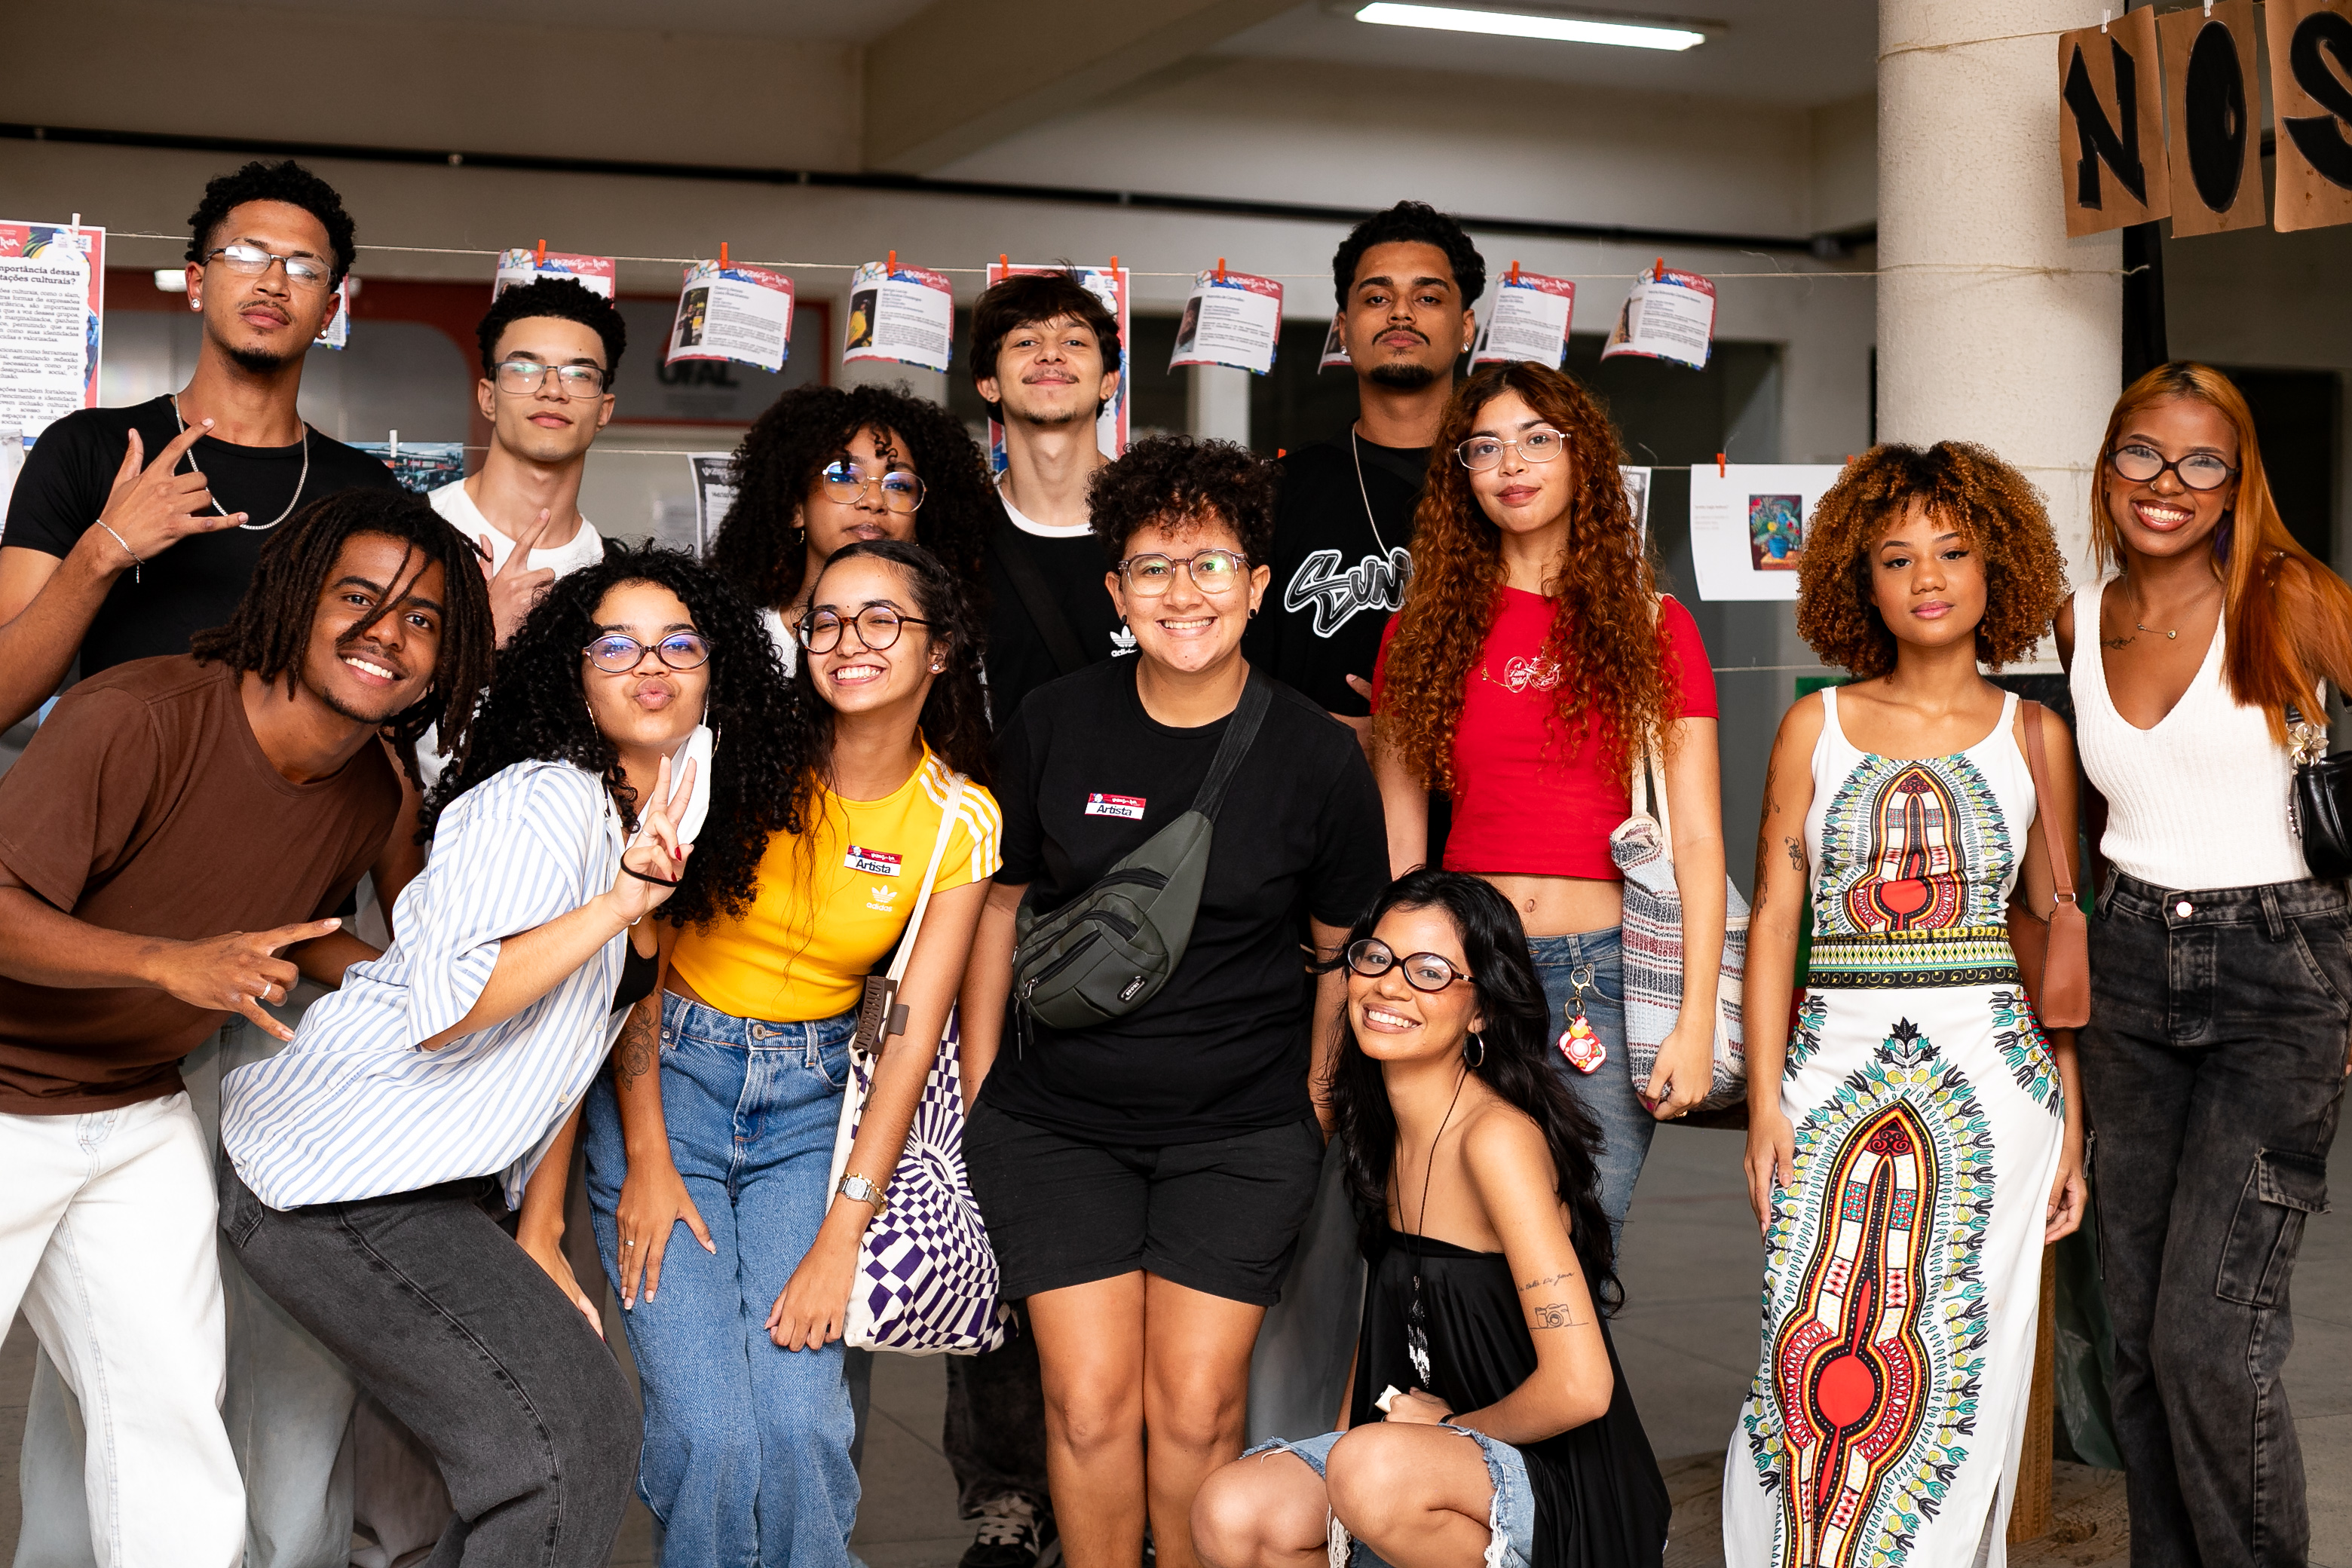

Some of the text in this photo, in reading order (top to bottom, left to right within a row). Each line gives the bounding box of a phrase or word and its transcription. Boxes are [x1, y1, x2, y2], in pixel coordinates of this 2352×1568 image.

[50, 268, 80, 276] dessas
[31, 276, 75, 285] culturais?
[1097, 805, 1132, 816] Artista
[856, 859, 891, 873] Artista
[866, 902, 893, 912] adidas
[1125, 982, 1140, 996] SPORT
